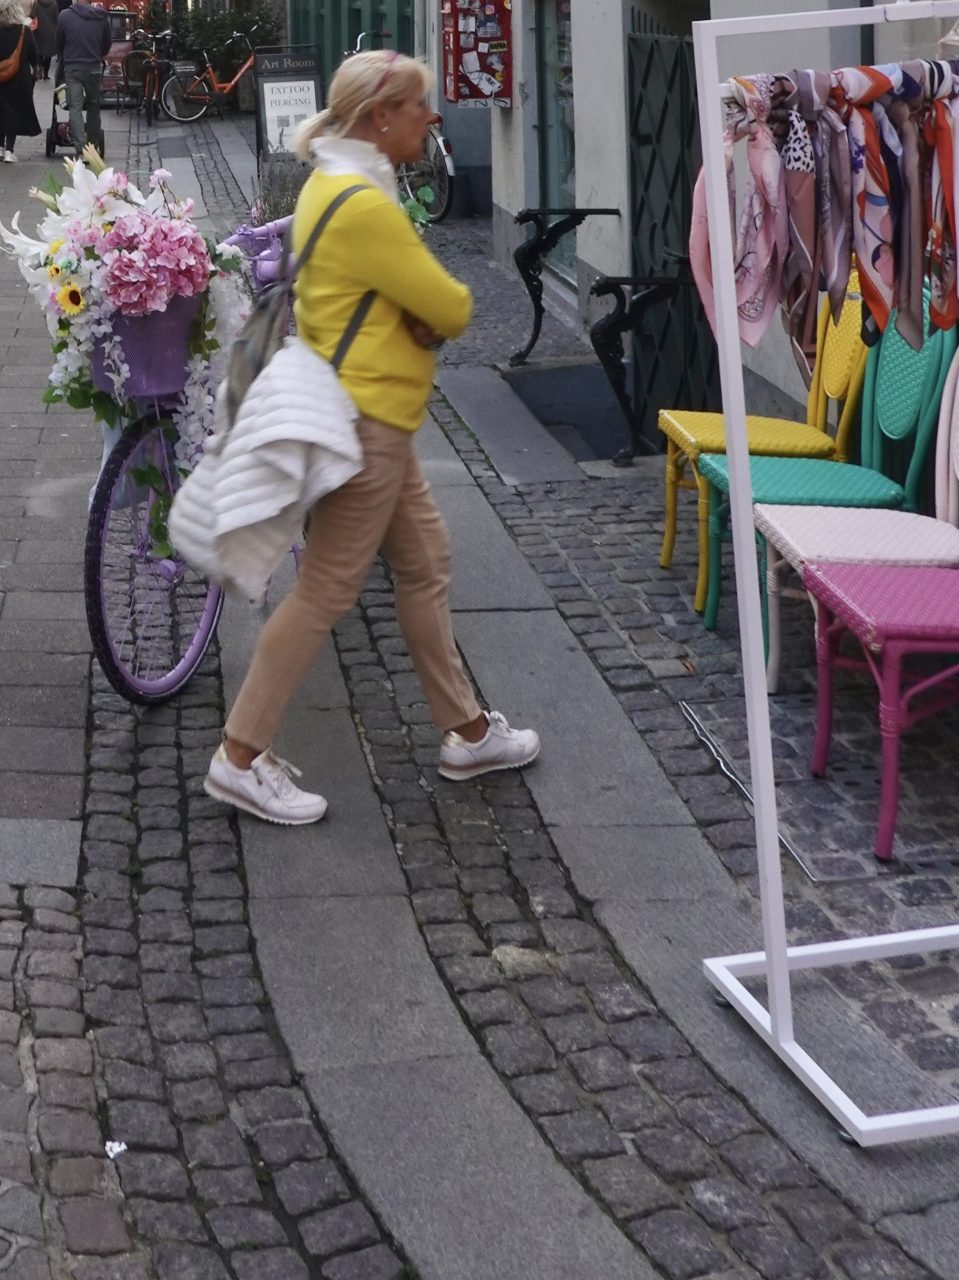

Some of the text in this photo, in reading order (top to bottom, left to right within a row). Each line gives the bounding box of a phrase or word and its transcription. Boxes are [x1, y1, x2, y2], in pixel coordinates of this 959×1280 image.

[262, 58, 315, 69] Art Room
[269, 85, 310, 95] TATTOO
[269, 97, 311, 107] PIERCING
